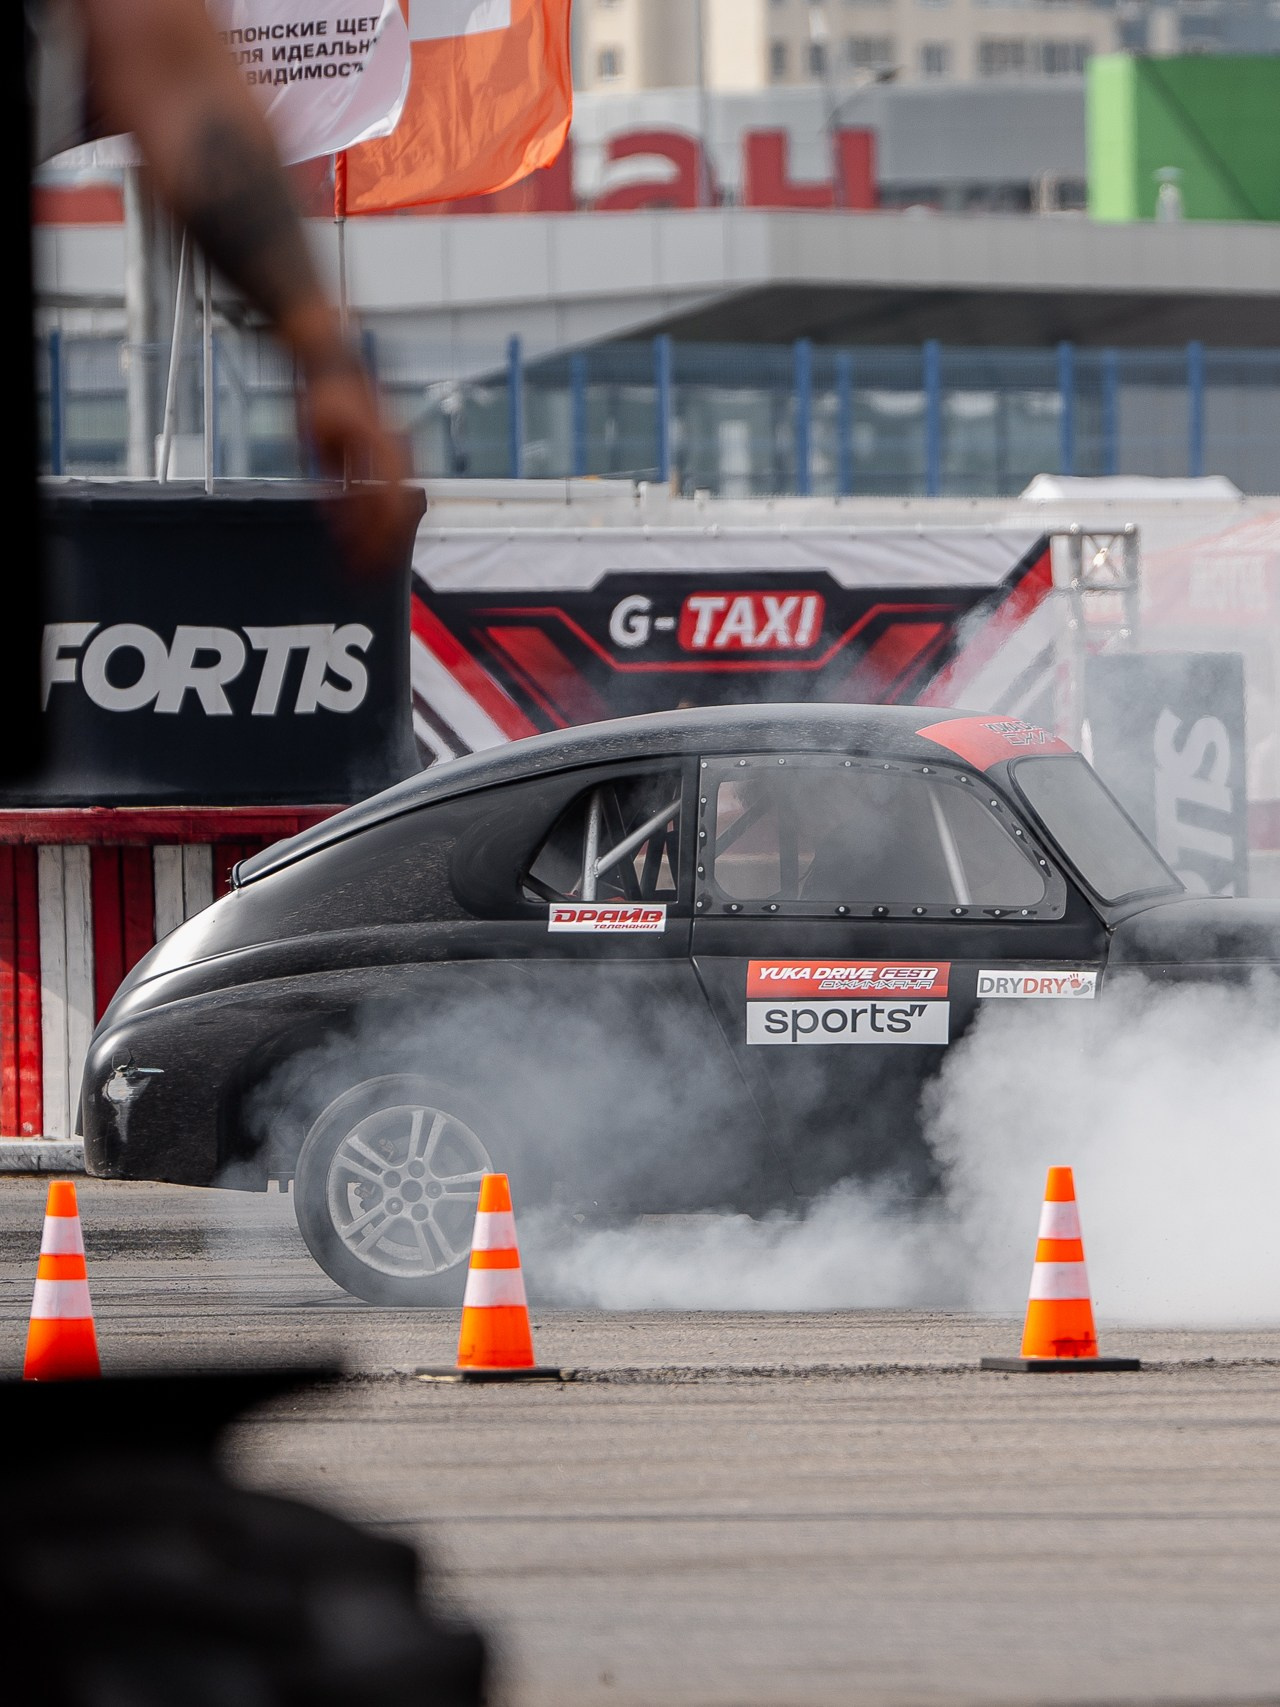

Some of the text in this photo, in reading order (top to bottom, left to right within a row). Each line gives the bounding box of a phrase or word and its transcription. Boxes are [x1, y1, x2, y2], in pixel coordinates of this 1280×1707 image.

[271, 37, 377, 62] ИДЕАЛЬН
[41, 622, 374, 717] FORTIS
[1153, 705, 1235, 896] TIS
[552, 907, 663, 923] ДРАЙВ
[759, 967, 938, 980] YUKA DRIVE FEST
[818, 979, 935, 990] ДЖИМХАНА
